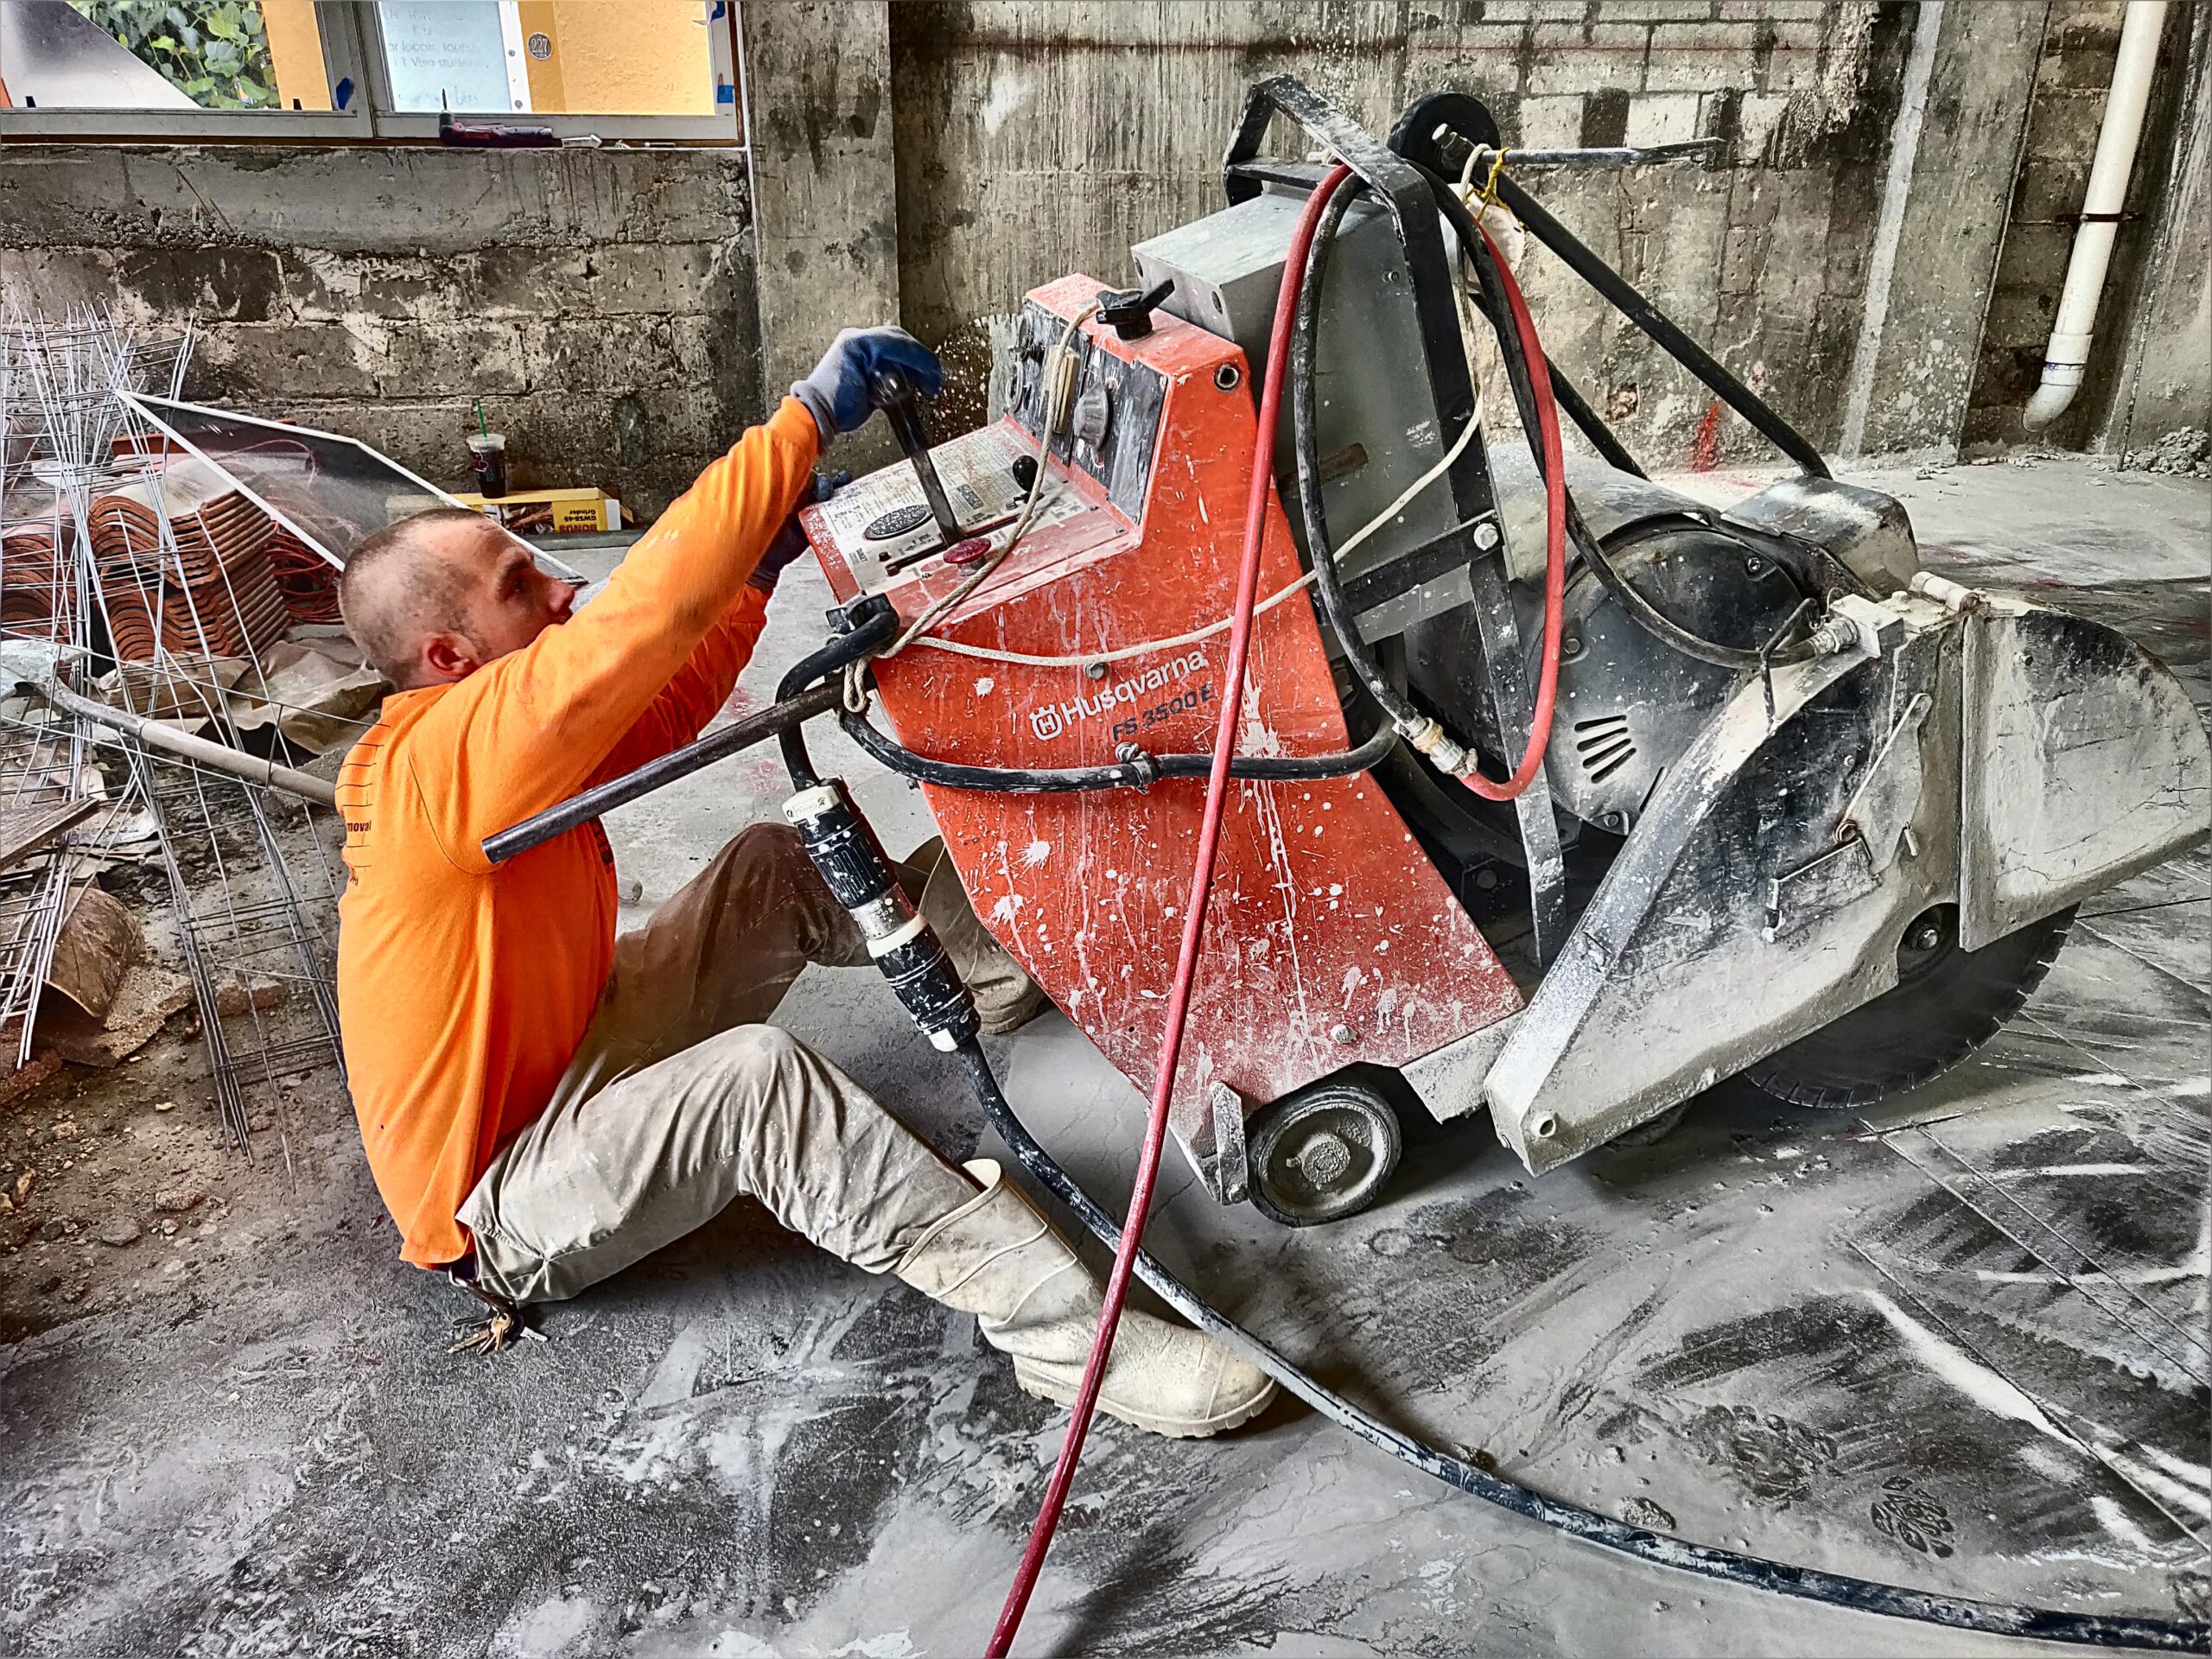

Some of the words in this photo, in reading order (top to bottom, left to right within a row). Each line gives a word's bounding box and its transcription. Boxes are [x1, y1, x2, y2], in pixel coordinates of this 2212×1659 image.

[531, 38, 548, 53] 227
[560, 524, 596, 533] BONUS
[1060, 651, 1206, 725] Husqvarna
[1112, 717, 1138, 741] FS
